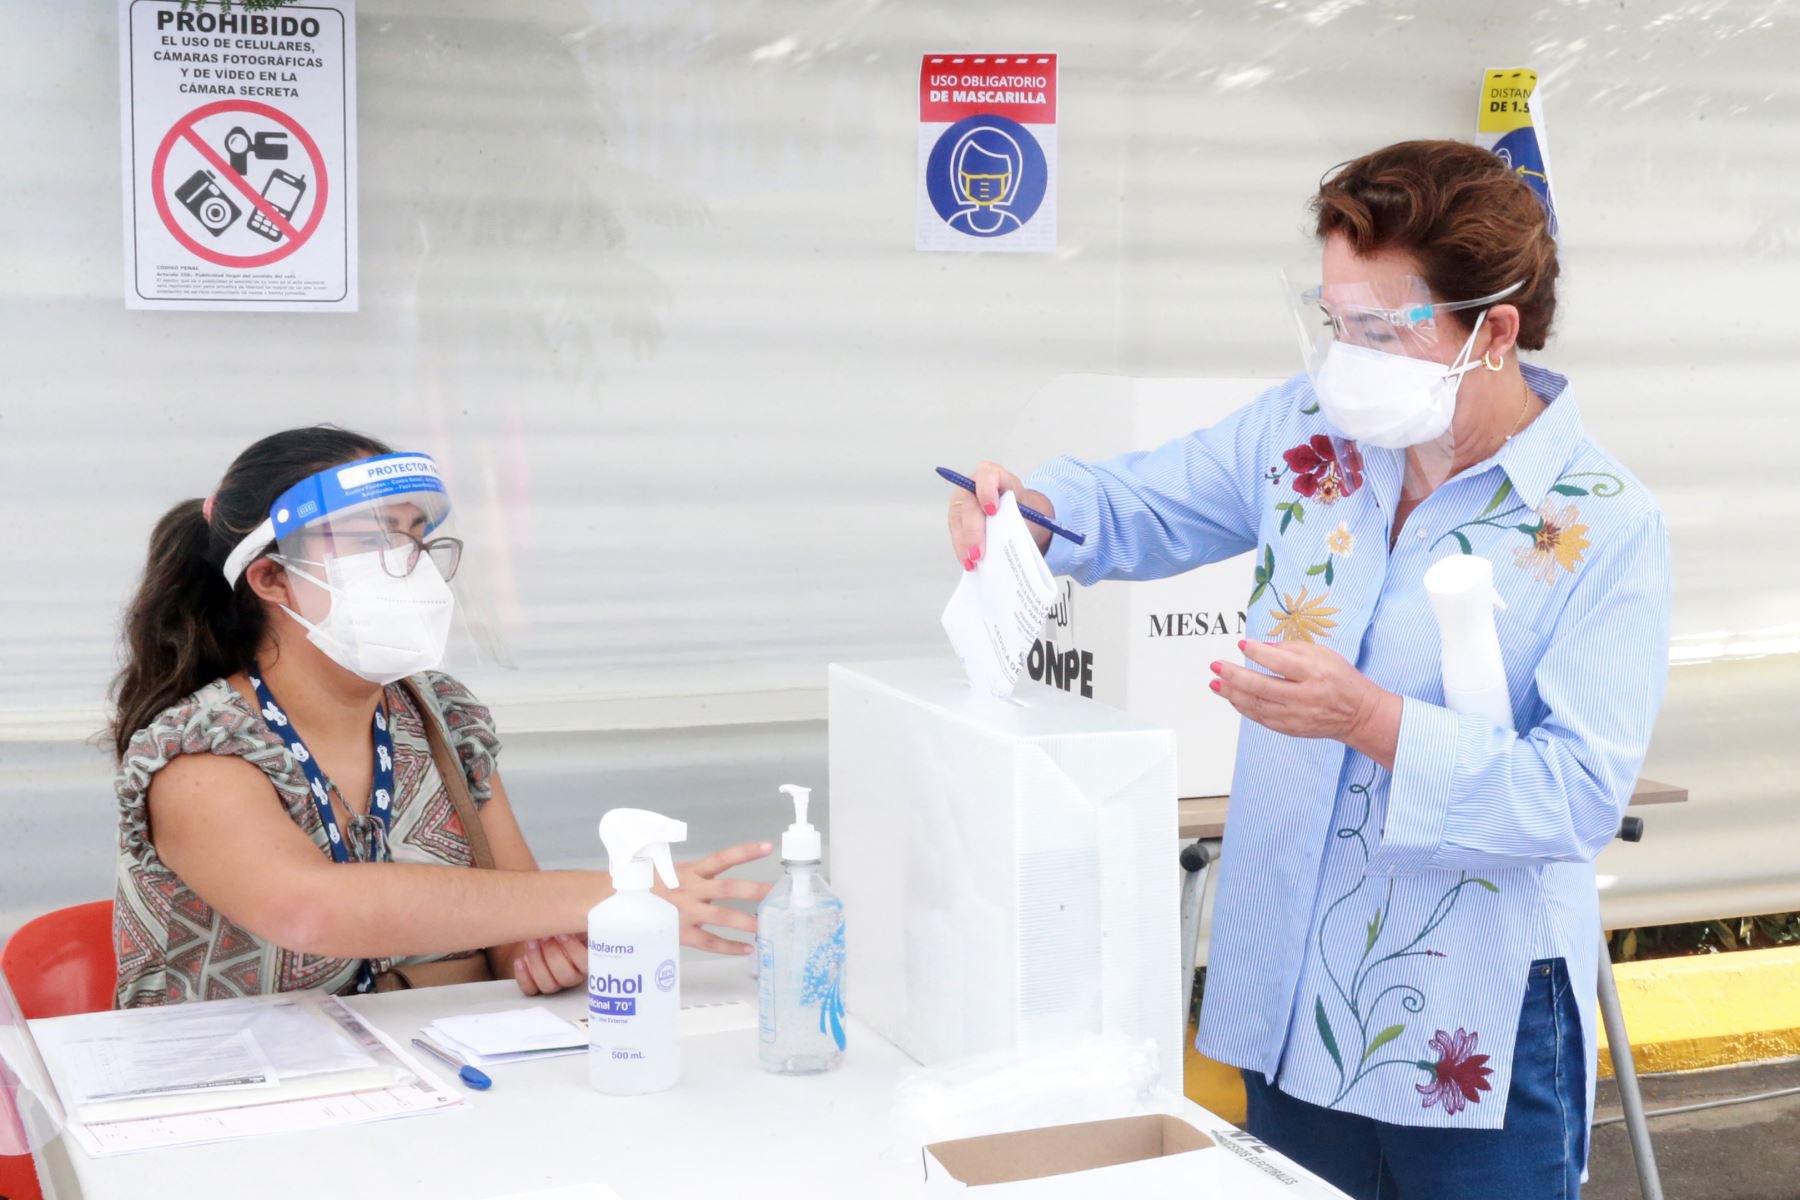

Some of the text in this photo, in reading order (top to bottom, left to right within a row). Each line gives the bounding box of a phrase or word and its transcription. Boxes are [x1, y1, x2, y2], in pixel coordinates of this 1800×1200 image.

[157, 10, 320, 38] PROHIBIDO
[161, 35, 315, 54] EL USO DE CELULARES,
[153, 50, 323, 68] CÁMARAS FOTOGRÁFICAS
[180, 68, 298, 82] Y DE VÍDEO EN LA
[930, 75, 1047, 88] USO OBLIGATORIO
[179, 81, 299, 98] CÁMARA SECRETA
[930, 90, 1047, 104] DE MASCARILLA
[1490, 101, 1508, 113] DE
[367, 462, 428, 477] PROTECTOR
[1148, 611, 1229, 638] MESA
[1027, 637, 1094, 699] ONPE
[611, 1051, 629, 1060] 500
